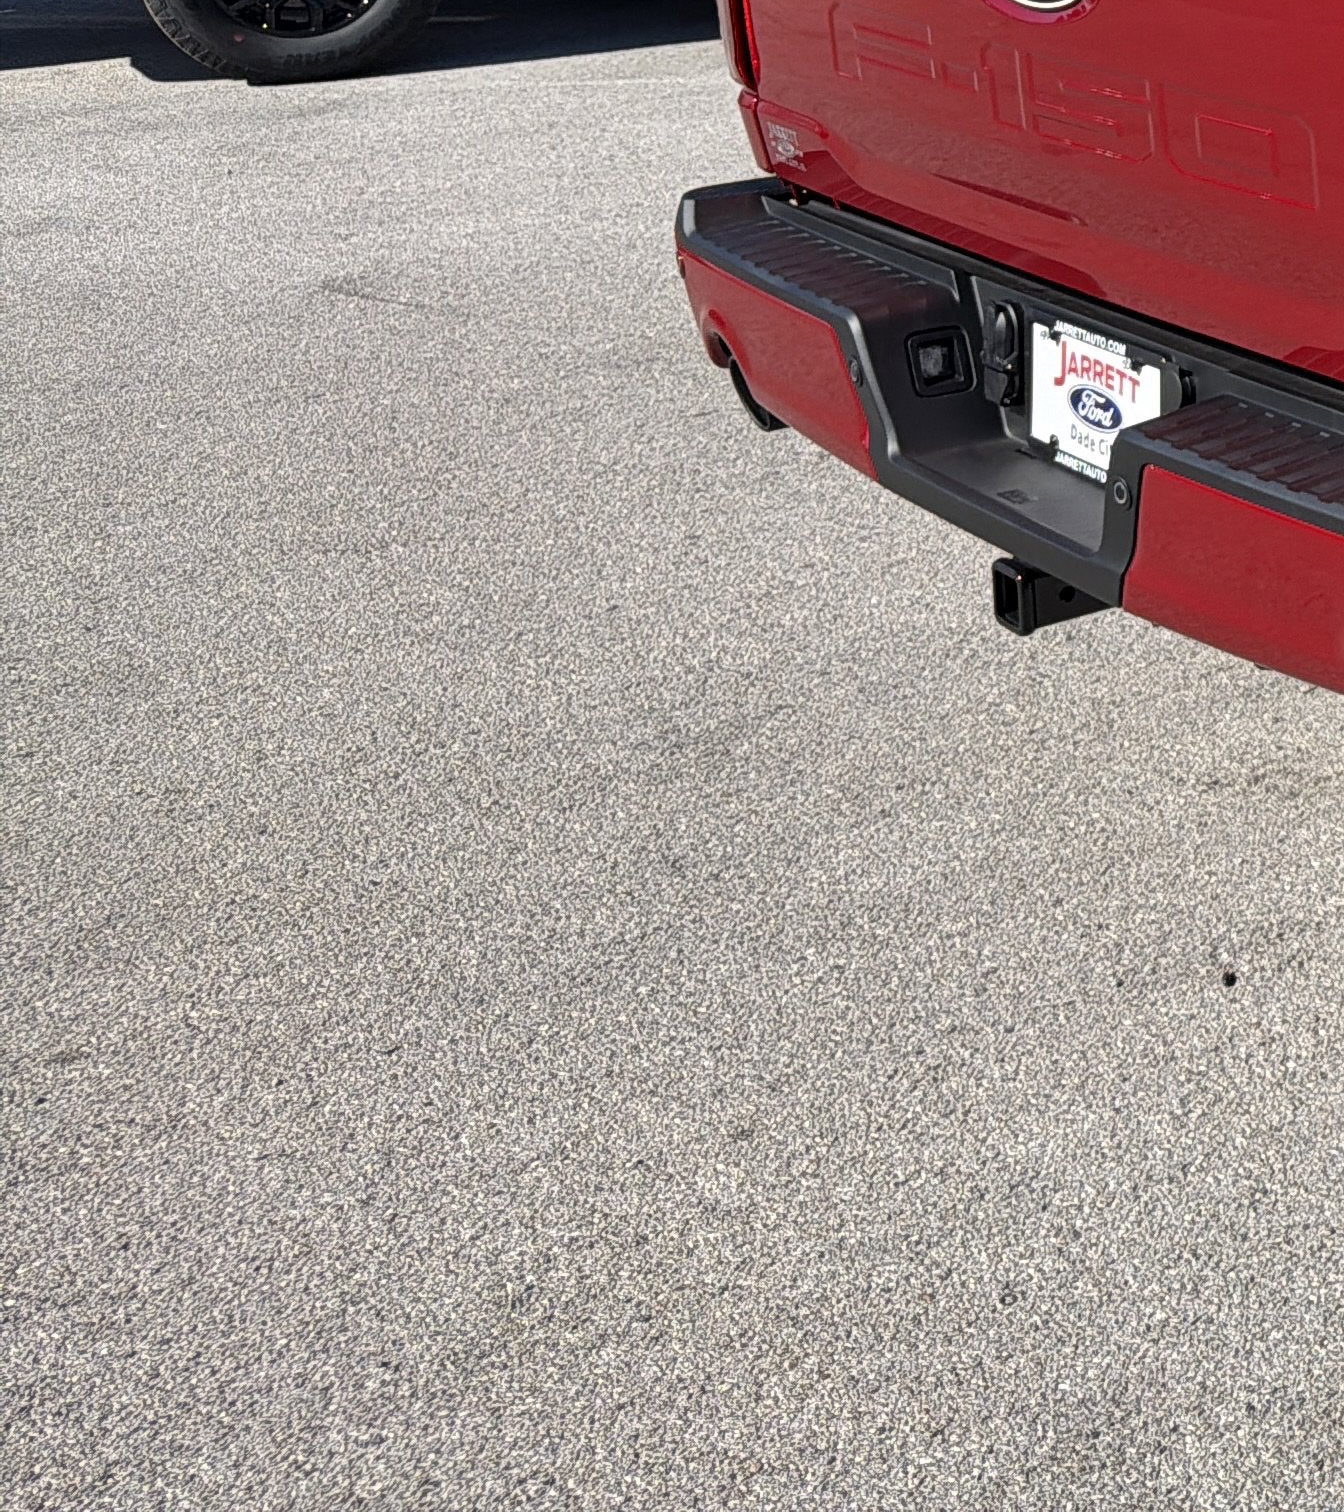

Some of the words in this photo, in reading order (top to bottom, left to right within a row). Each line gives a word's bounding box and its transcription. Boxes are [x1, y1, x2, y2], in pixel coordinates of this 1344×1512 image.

[1054, 320, 1126, 355] JARRETTAUTO.COM
[1054, 340, 1140, 404] JARRETT
[1078, 389, 1115, 427] Ford
[1070, 423, 1095, 452] Dade
